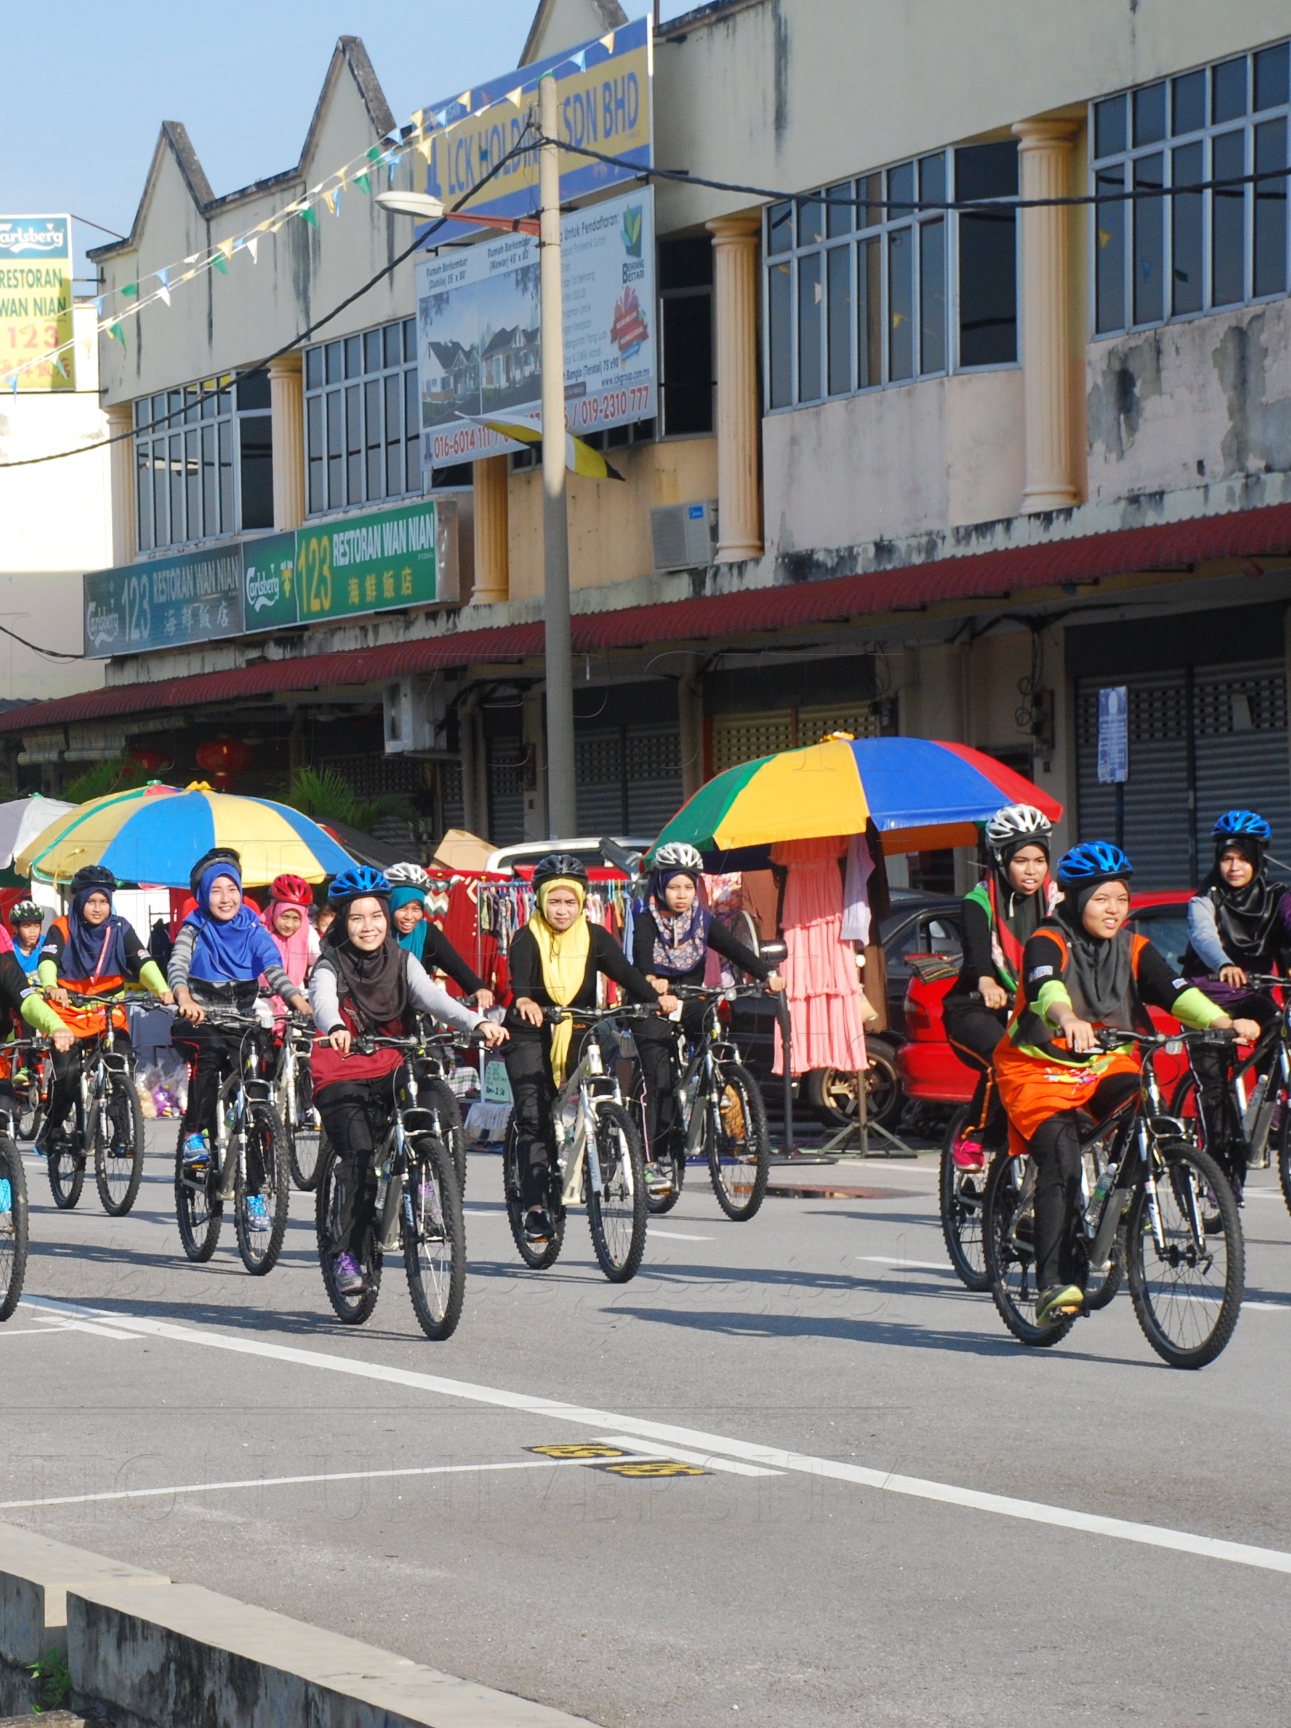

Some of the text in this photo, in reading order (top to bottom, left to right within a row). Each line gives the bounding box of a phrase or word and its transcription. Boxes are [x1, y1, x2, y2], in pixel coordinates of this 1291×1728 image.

[447, 72, 639, 196] LCK HOLDIN SDN BHD
[426, 265, 441, 278] Rumah
[33, 296, 67, 317] NIAN
[7, 325, 60, 349] 123
[581, 390, 627, 425] 019-2310
[630, 384, 650, 413] 777
[434, 431, 475, 459] 016-6014
[298, 513, 434, 614] 123 RESTORAN WAN NIAN
[121, 555, 239, 642] 123 RESTORAN WAN NIAN
[246, 565, 279, 606] Carlsberg
[87, 600, 119, 641] Carlsberg
